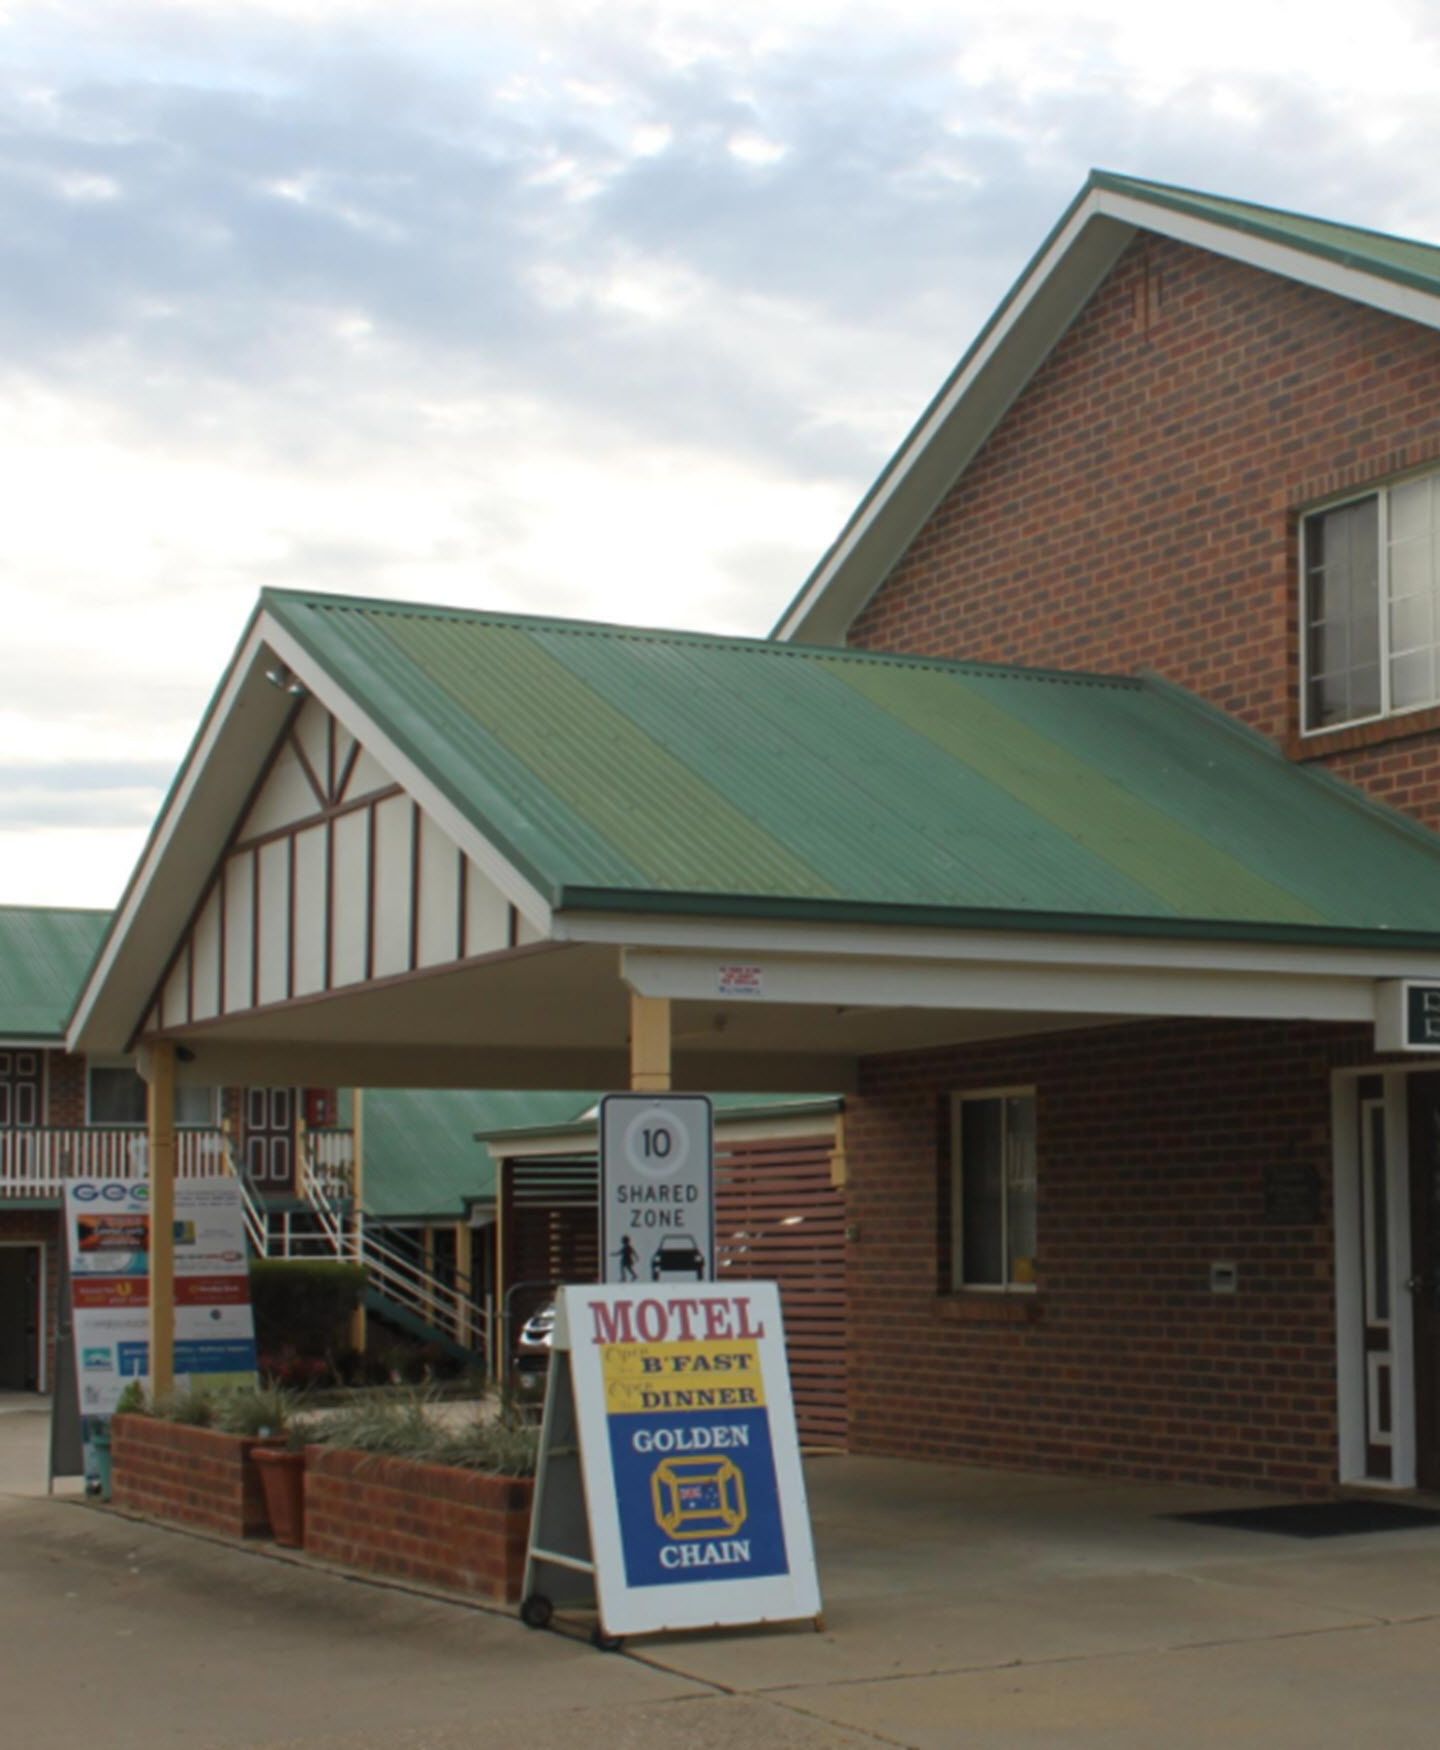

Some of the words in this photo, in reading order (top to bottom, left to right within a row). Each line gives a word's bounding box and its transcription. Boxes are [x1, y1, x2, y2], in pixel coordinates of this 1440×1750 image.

[642, 1128, 671, 1157] 10
[617, 1184, 699, 1204] SHARED
[630, 1208, 685, 1228] ZONE
[588, 1297, 765, 1345] MOTEL
[641, 1353, 752, 1374] B'FAST
[640, 1387, 757, 1408] DINNER
[632, 1425, 750, 1454] GOLDEN
[659, 1540, 751, 1569] CHAIN
